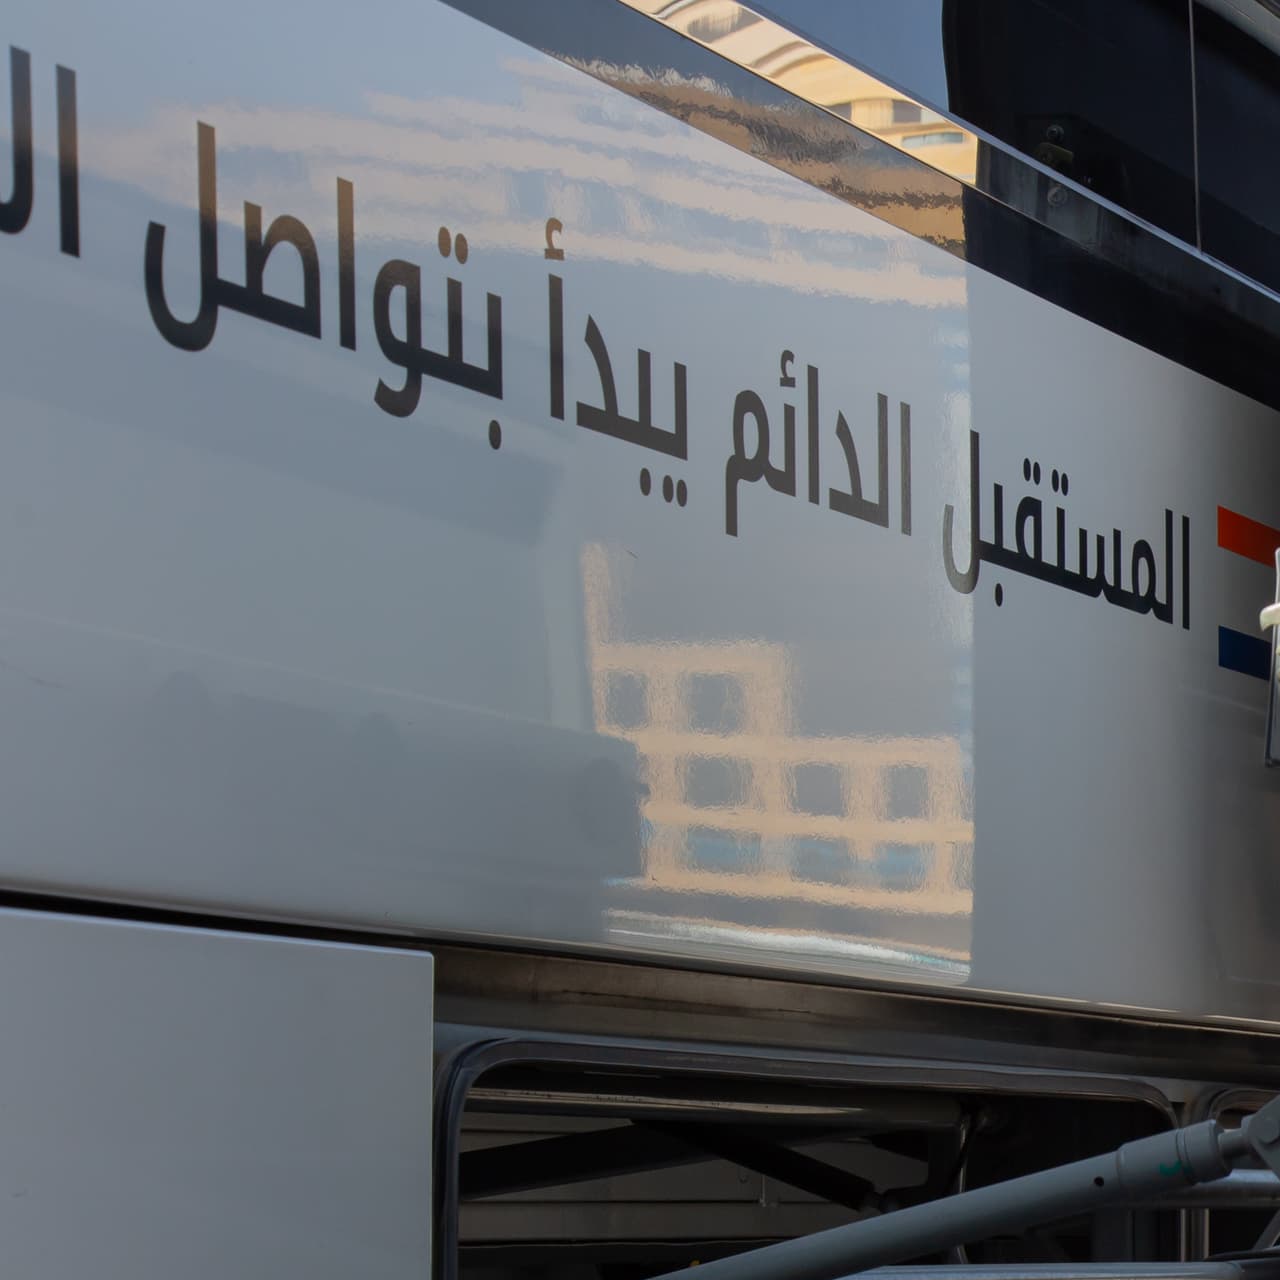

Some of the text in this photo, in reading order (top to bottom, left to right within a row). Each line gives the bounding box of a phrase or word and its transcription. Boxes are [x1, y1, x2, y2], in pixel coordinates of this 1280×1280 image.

[144, 120, 503, 451] بتواصل
[545, 217, 688, 507] يبدأ
[725, 349, 912, 537] الدائم
[942, 429, 1190, 630] المستقبل
